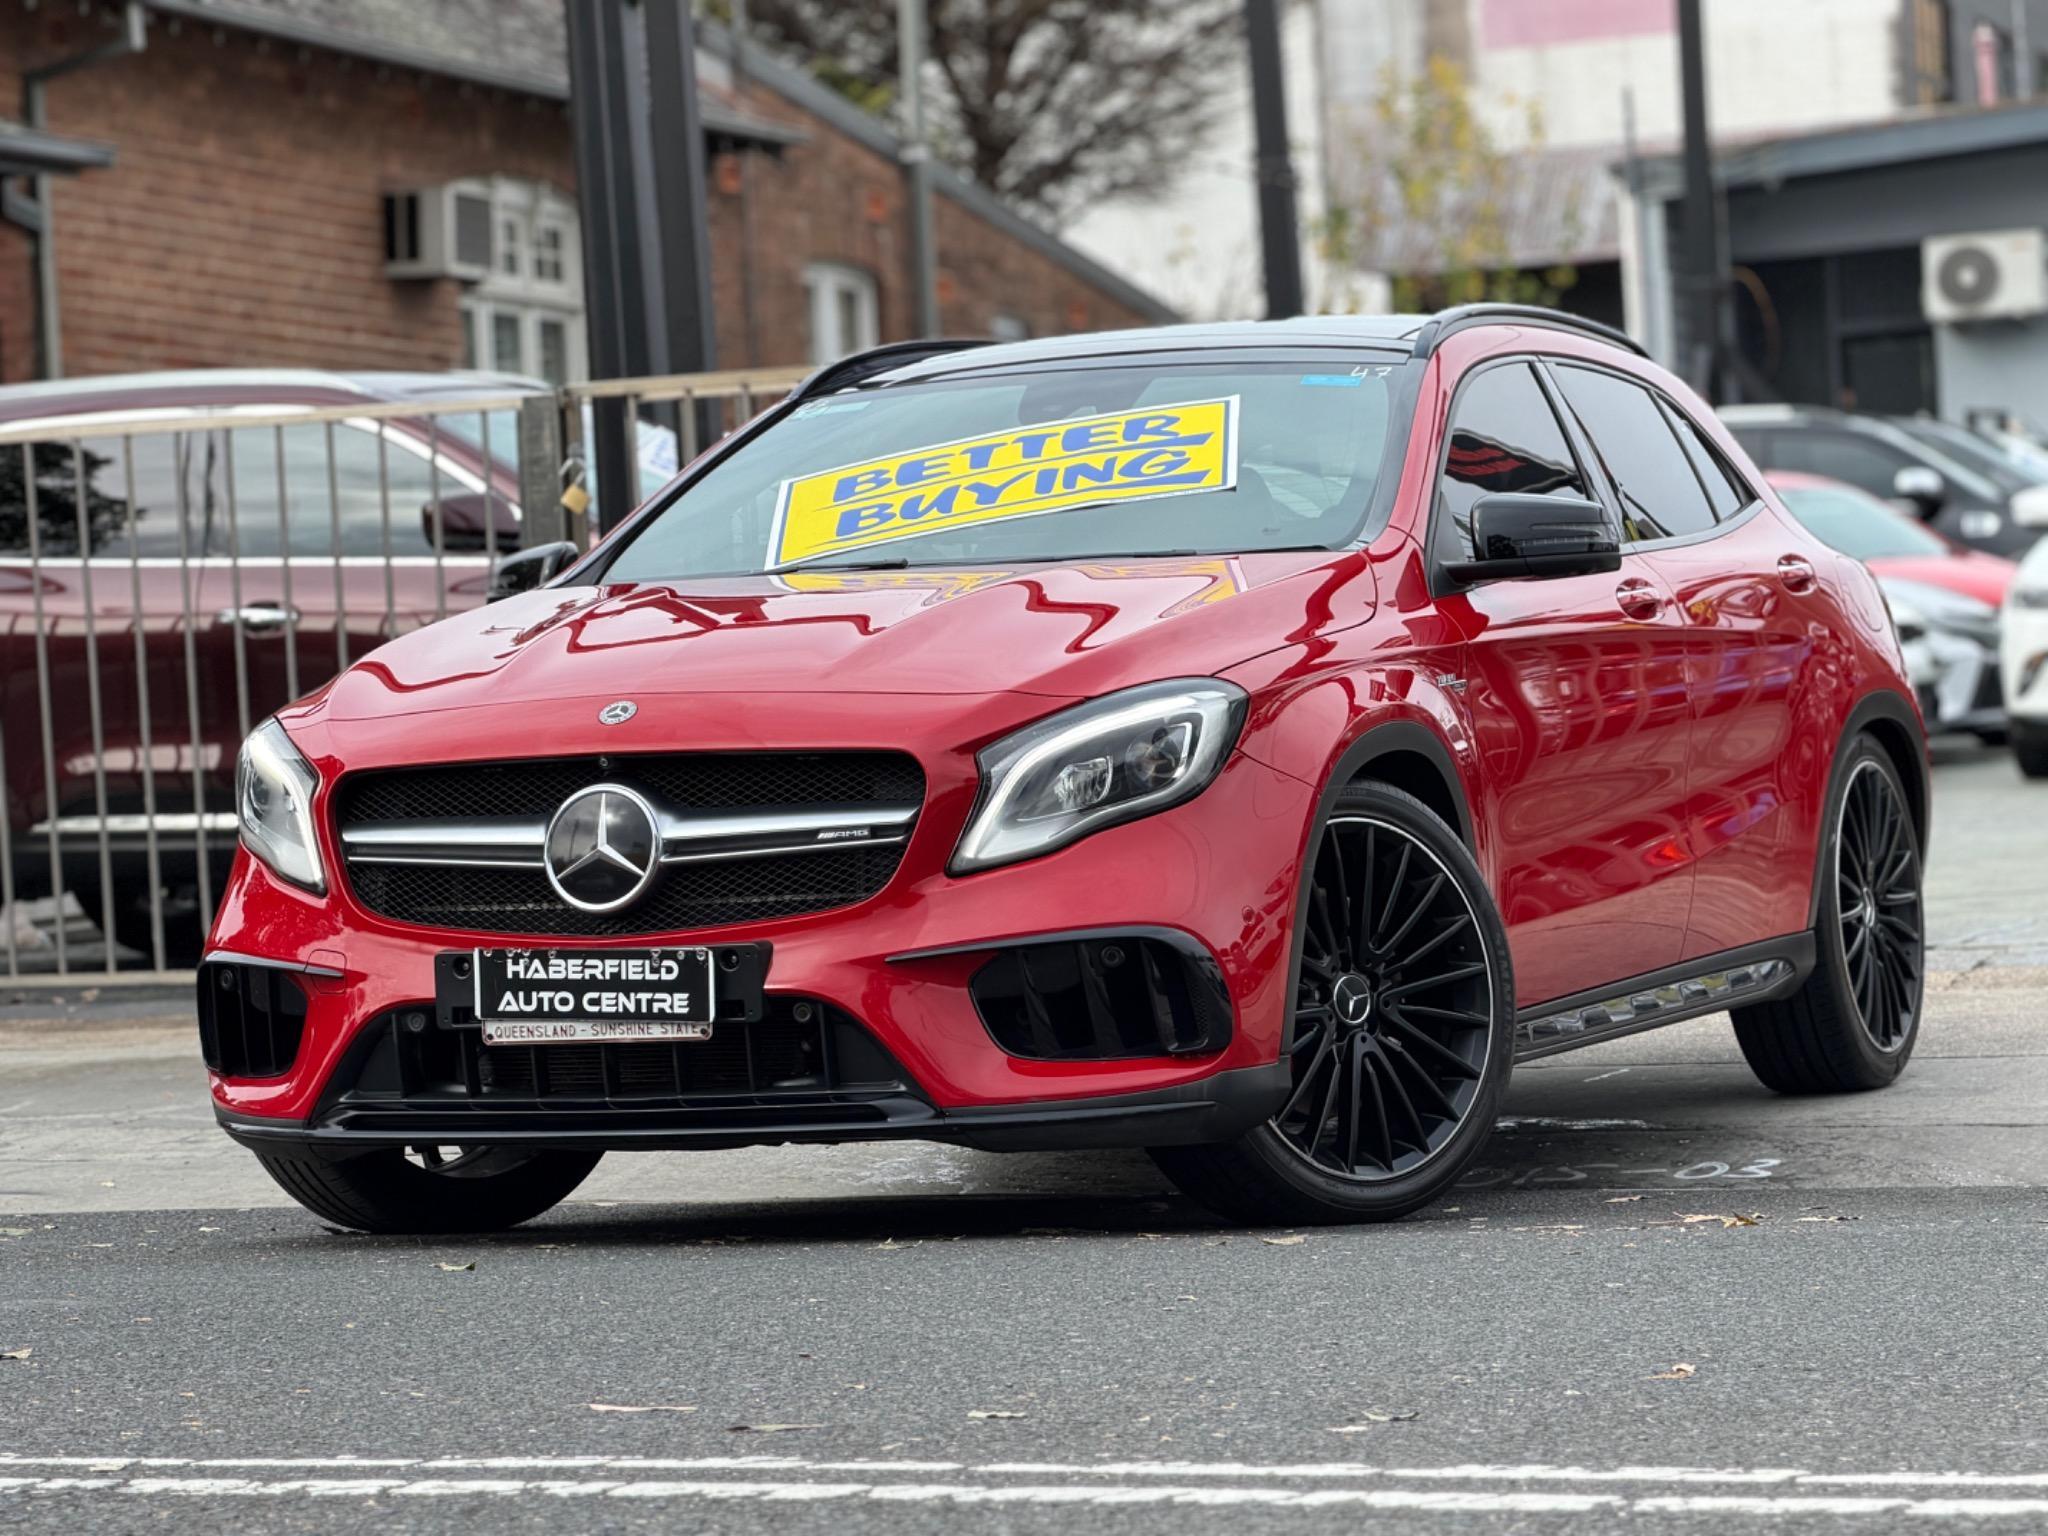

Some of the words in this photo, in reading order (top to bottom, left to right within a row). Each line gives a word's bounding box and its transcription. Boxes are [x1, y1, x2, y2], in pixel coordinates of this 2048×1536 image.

[833, 415, 1181, 503] BETTER
[835, 448, 1192, 537] BUYING
[506, 958, 680, 981] HABERFIELD
[497, 990, 575, 1012] AUTO
[582, 992, 690, 1014] CENTRE
[494, 1025, 577, 1039] QUEENSLAND
[591, 1023, 653, 1037] SUNSHINE
[660, 1022, 698, 1035] STATE
